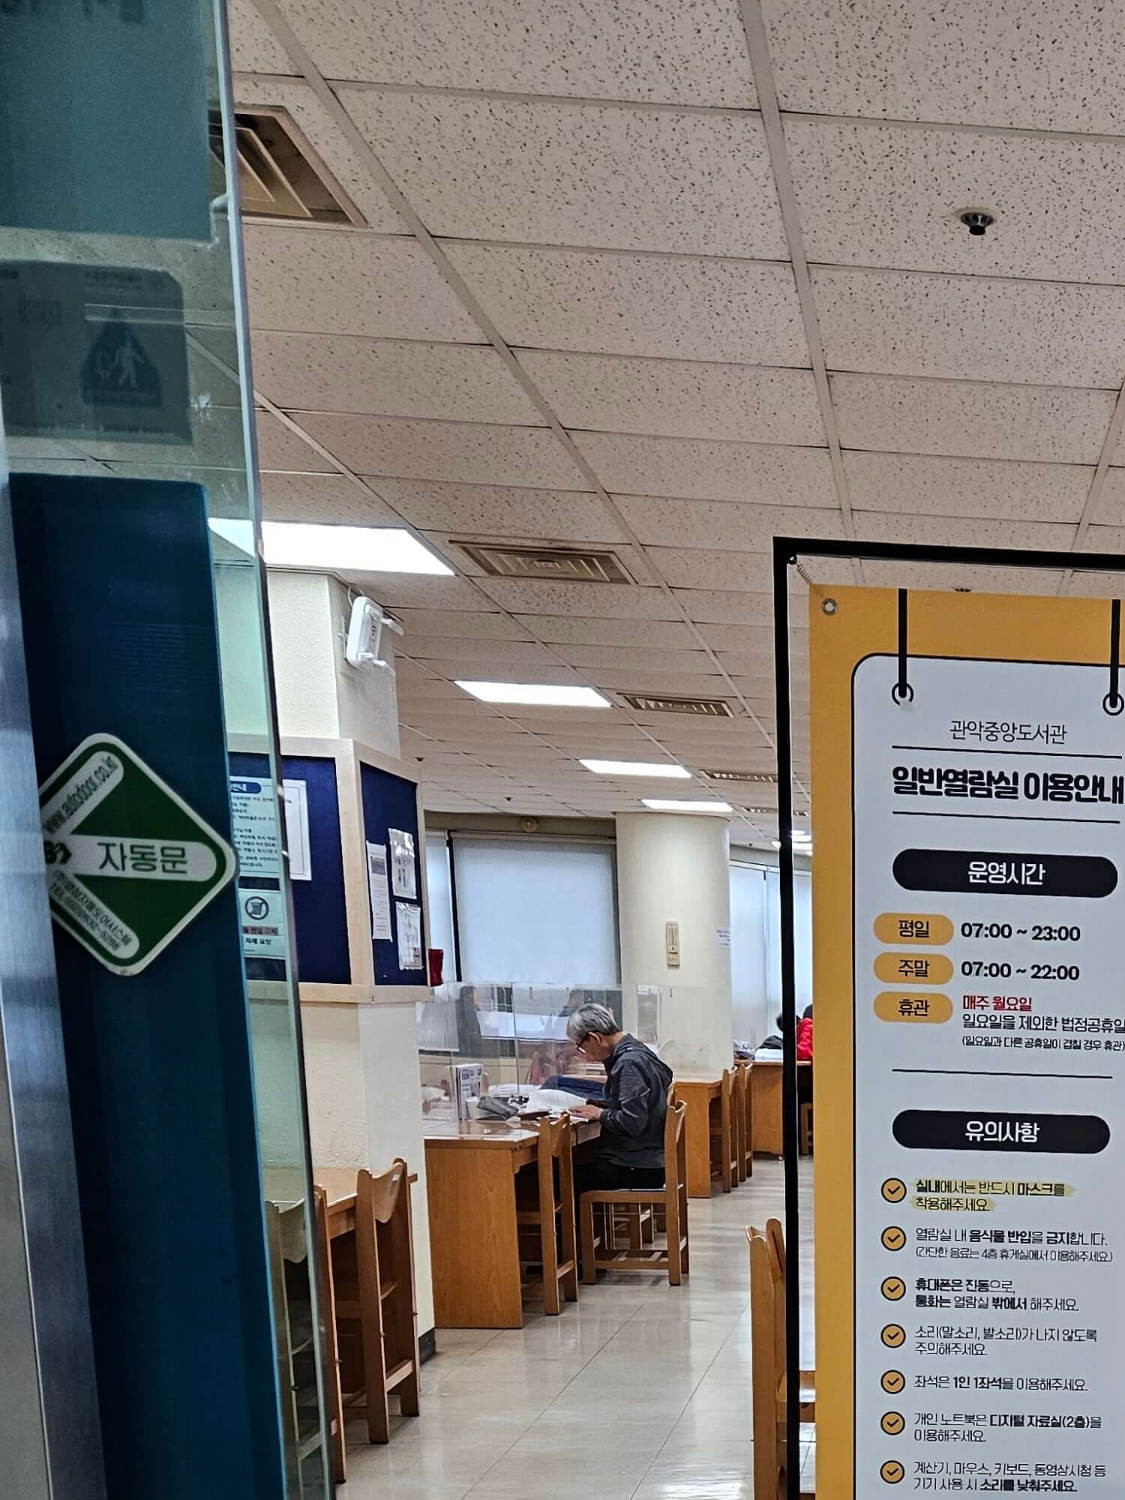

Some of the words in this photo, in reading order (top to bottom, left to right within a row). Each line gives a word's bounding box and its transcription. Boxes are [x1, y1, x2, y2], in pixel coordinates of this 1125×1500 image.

[949, 719, 1067, 745] 관악중앙도서관
[892, 765, 1019, 800] 일반열람실
[1023, 771, 1124, 804] 이용안내
[97, 841, 188, 875] 자동문
[967, 860, 1046, 886] 운영시간
[898, 919, 929, 938] 평일
[960, 921, 1012, 939] 07:00
[1031, 924, 1081, 942] 23:00
[898, 959, 930, 978] 주말
[960, 960, 1011, 978] 07:00
[1030, 963, 1080, 981] 22:00
[897, 998, 930, 1017] 휴관
[962, 994, 990, 1011] 매주
[992, 995, 1032, 1012] 월요일
[962, 1013, 1016, 1030] 일요일을
[1018, 1014, 1059, 1031] 제외한
[964, 1119, 1040, 1144] 유의사항
[915, 1178, 976, 1195] 실내에서는
[978, 1180, 1014, 1196] 반드시
[1017, 1181, 1065, 1197] 마스크를
[915, 1227, 951, 1242] 열람실
[954, 1228, 966, 1242] 내
[968, 1228, 1005, 1243] 음식물
[1007, 1229, 1043, 1244] 반입을
[1045, 1230, 1108, 1247] 금지합니다.
[914, 1277, 963, 1292] 휴대폰은
[965, 1278, 1015, 1295] 진동으로,
[915, 1294, 951, 1308] 통화는
[953, 1295, 989, 1310] 열람실
[991, 1295, 1027, 1311] 밖에서
[915, 1324, 980, 1340] 소리(말소리,
[983, 1325, 1034, 1342] 발소리)가
[1036, 1327, 1059, 1341] 나지
[1061, 1327, 1097, 1343] 않도록
[914, 1374, 950, 1389] 좌석은
[952, 1375, 970, 1389] 1인
[973, 1375, 1014, 1390] 1좌석을
[914, 1412, 938, 1425] 개인
[940, 1412, 987, 1427] 노트북은
[989, 1413, 1025, 1428] 디지털
[1026, 1413, 1102, 1430] 자료실(2층)을
[913, 1460, 951, 1475] 계산기,
[953, 1461, 992, 1476] 마우스,
[994, 1462, 1032, 1477] 키보드,
[1033, 1462, 1091, 1478] 동영상시청
[1093, 1465, 1106, 1477] 등
[913, 1476, 936, 1490] 기기
[939, 1477, 963, 1490] 사용
[965, 1478, 977, 1490] 시
[979, 1477, 1015, 1492] 소리를
